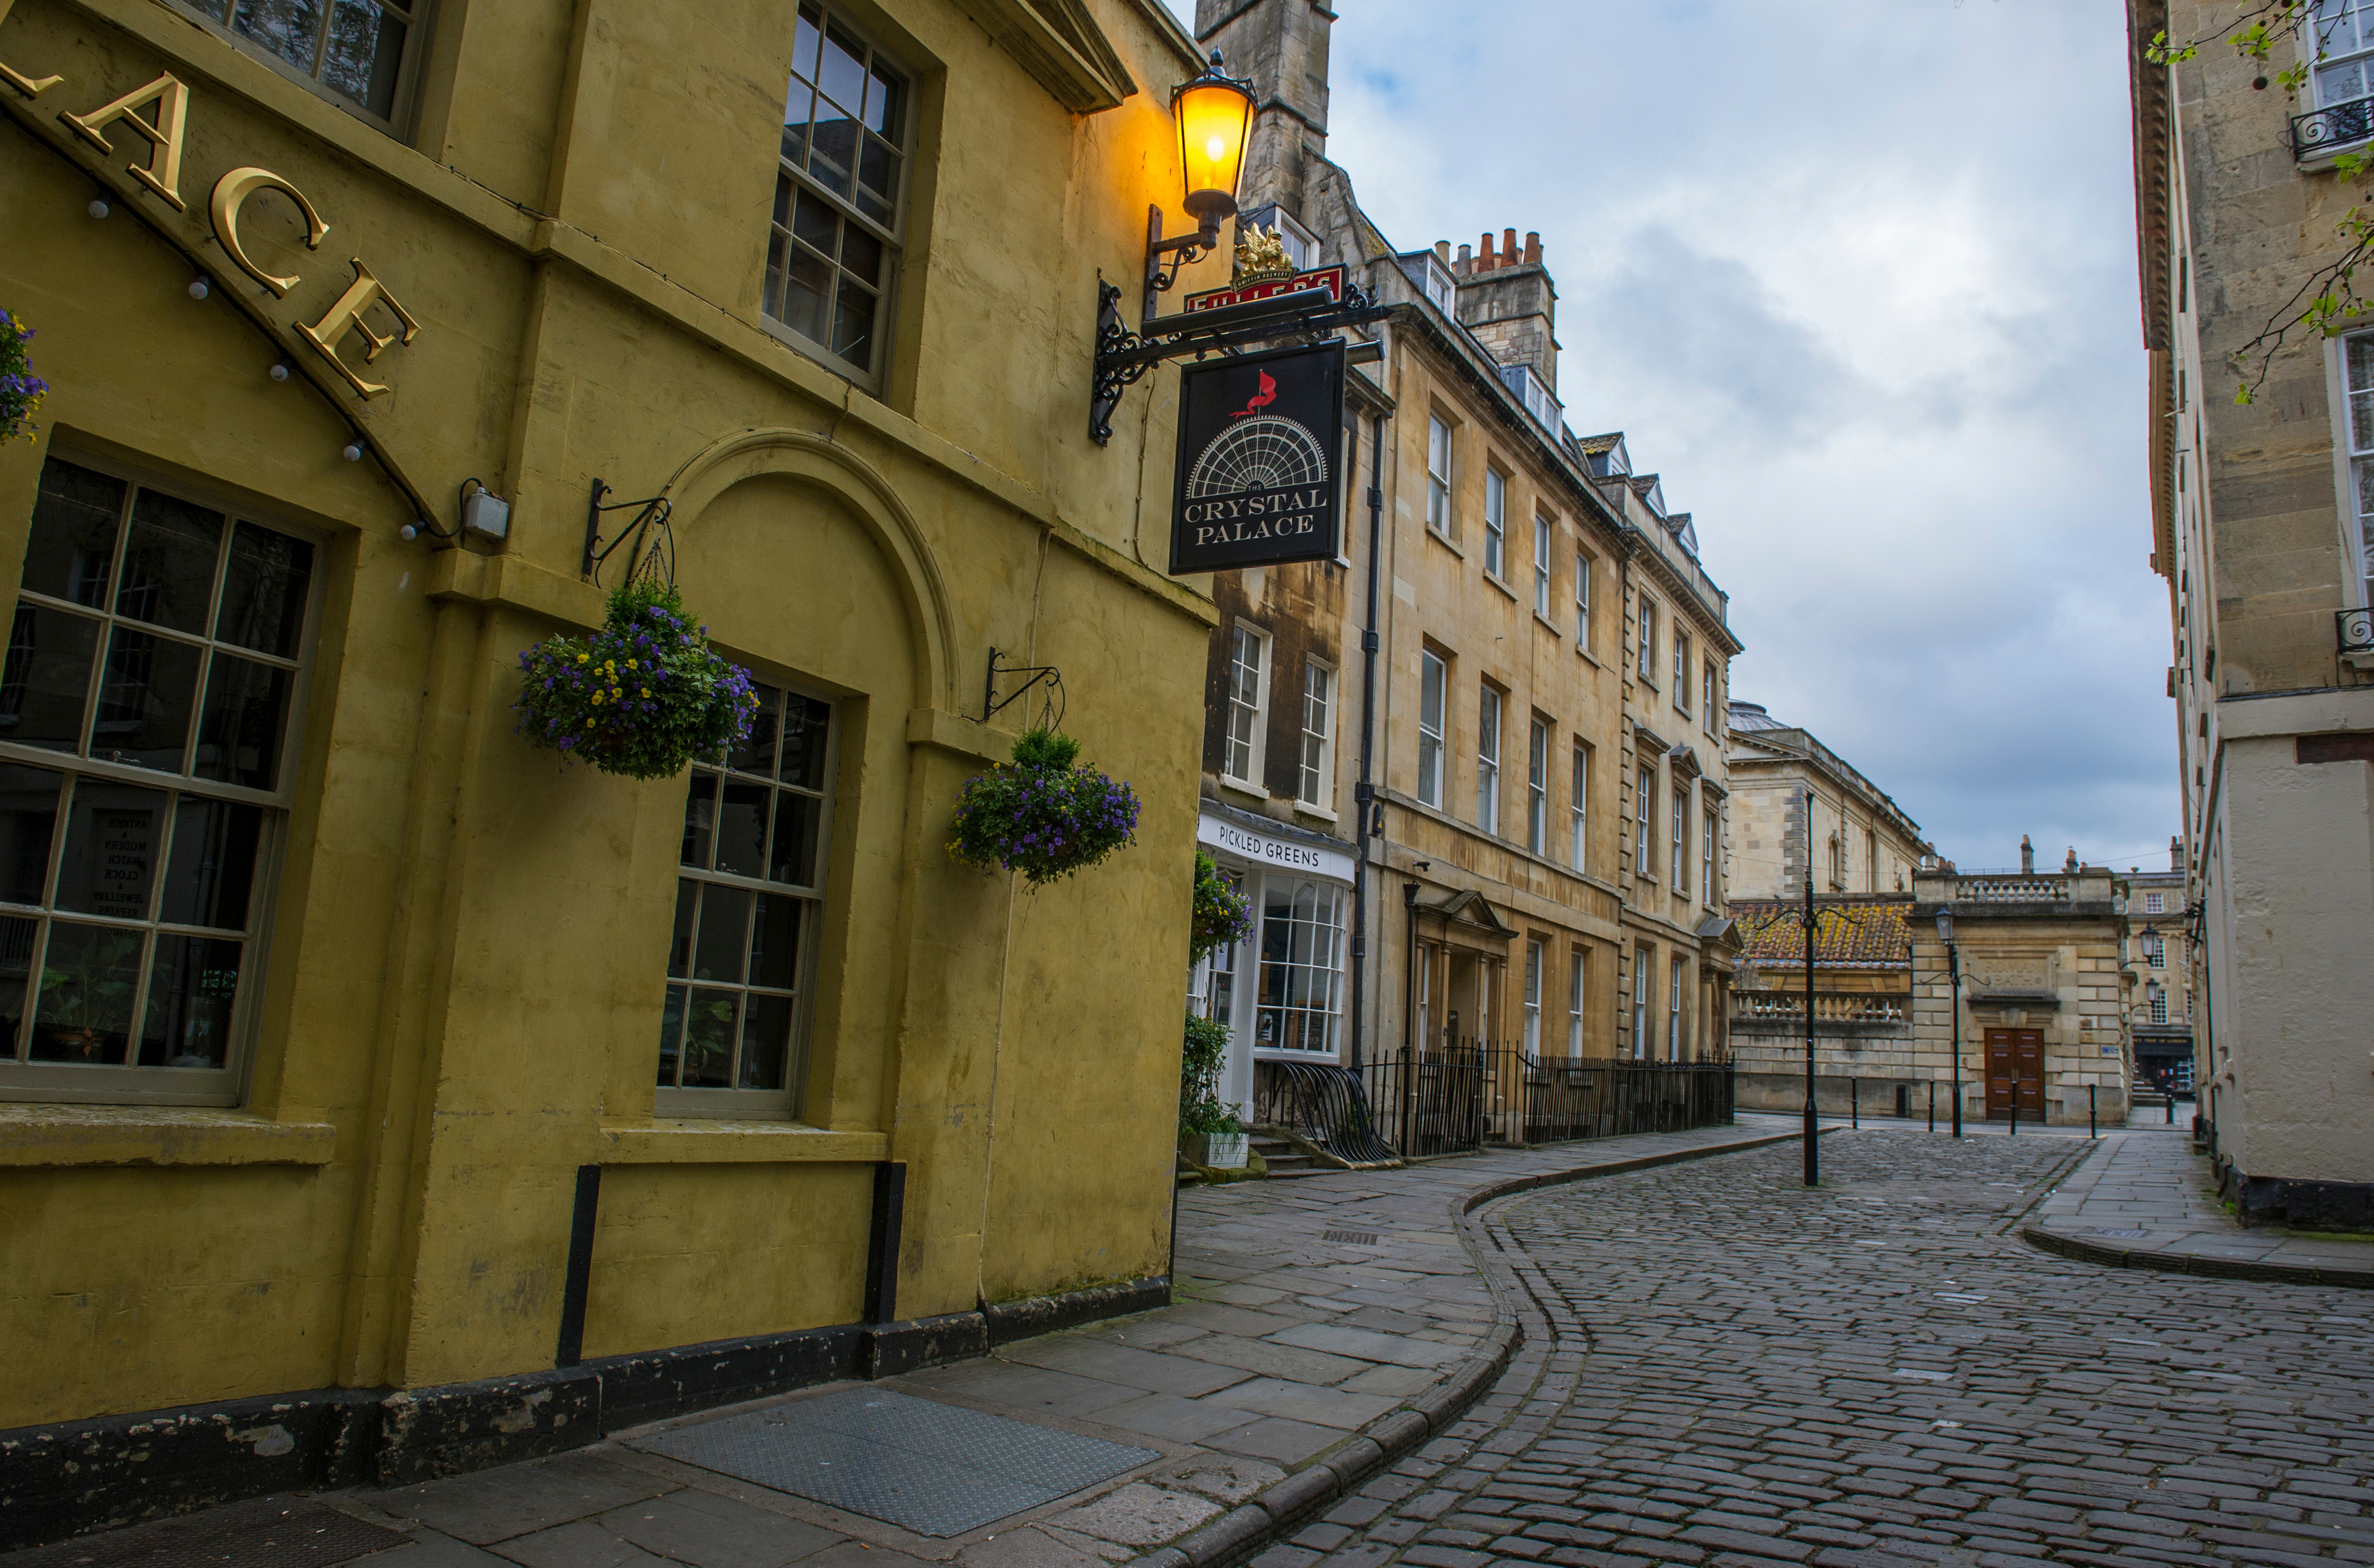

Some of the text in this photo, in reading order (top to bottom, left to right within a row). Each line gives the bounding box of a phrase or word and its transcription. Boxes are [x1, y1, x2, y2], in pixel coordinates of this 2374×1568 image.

[1237, 275, 1260, 287] GRIFFIN
[1184, 489, 1327, 523] CRYSTAL
[1195, 515, 1313, 545] PALACE
[1220, 826, 1318, 867] PICKLED GREENS
[1985, 961, 2041, 973] ROMAN
[1994, 975, 2032, 986] BATH
